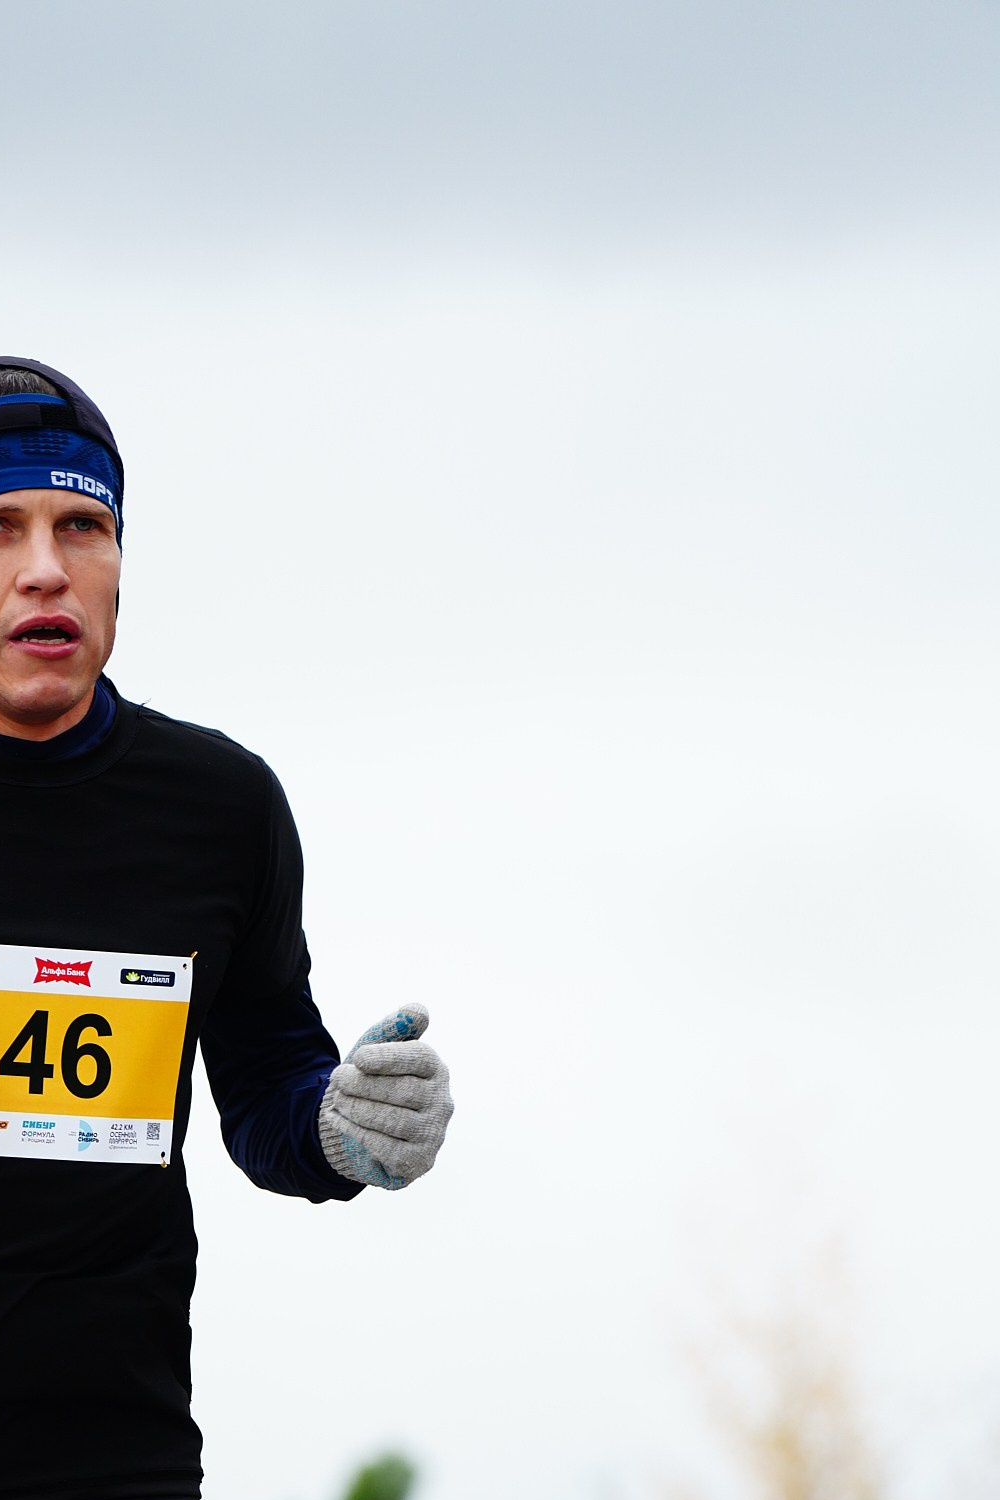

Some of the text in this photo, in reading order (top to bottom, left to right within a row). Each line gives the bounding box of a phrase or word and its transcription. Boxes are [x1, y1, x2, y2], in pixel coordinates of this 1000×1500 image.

[51, 471, 119, 528] СПОРТ
[41, 966, 86, 977] Альфа Банк
[140, 974, 170, 984] Гудвилл
[22, 1120, 56, 1129] СИБУР
[110, 1123, 123, 1131] 42.2
[21, 1130, 56, 1138] ФОРМУЛА
